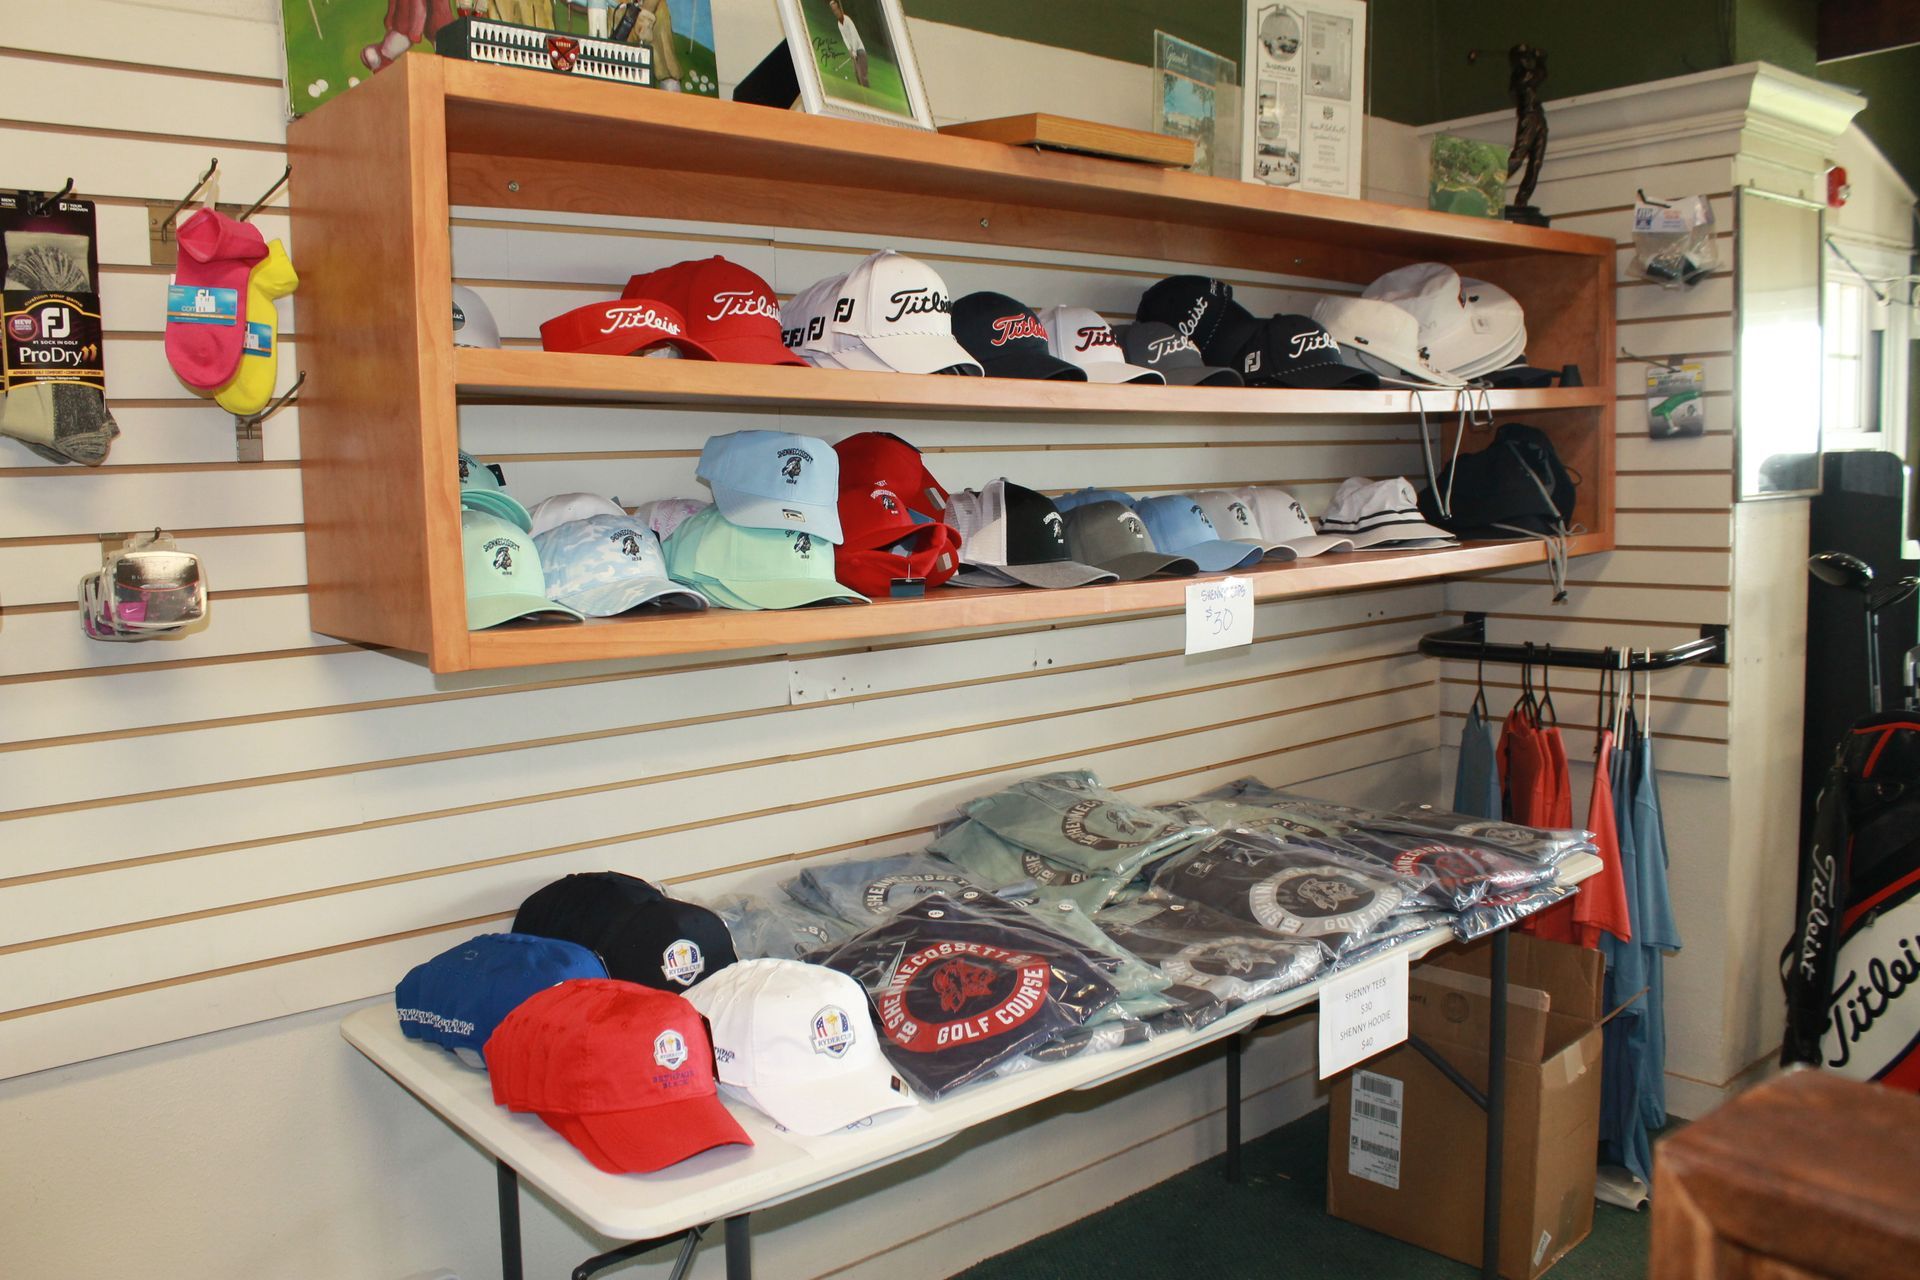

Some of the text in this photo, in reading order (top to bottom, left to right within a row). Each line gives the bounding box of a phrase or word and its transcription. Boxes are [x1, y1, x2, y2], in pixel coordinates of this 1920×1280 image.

[600, 305, 680, 335] Titleist
[833, 298, 855, 322] FJ
[41, 307, 70, 338] FJ
[807, 316, 825, 341] FJ
[20, 347, 82, 366] ProDry
[1245, 350, 1261, 374] FJ
[1206, 607, 1233, 635] $30
[1801, 844, 1836, 982] Titleist
[669, 967, 689, 976] RYDER
[995, 968, 1043, 1025] COURSE
[1345, 977, 1386, 1002] SHENNY TEES
[1361, 1001, 1372, 1015] $30
[897, 1022, 918, 1043] 18
[937, 1016, 990, 1044] GOLF
[1340, 1010, 1391, 1041] SHENNY HOODIE
[818, 1036, 840, 1047] RYDER
[1361, 1037, 1374, 1051] $40
[716, 1055, 730, 1063] ACK
